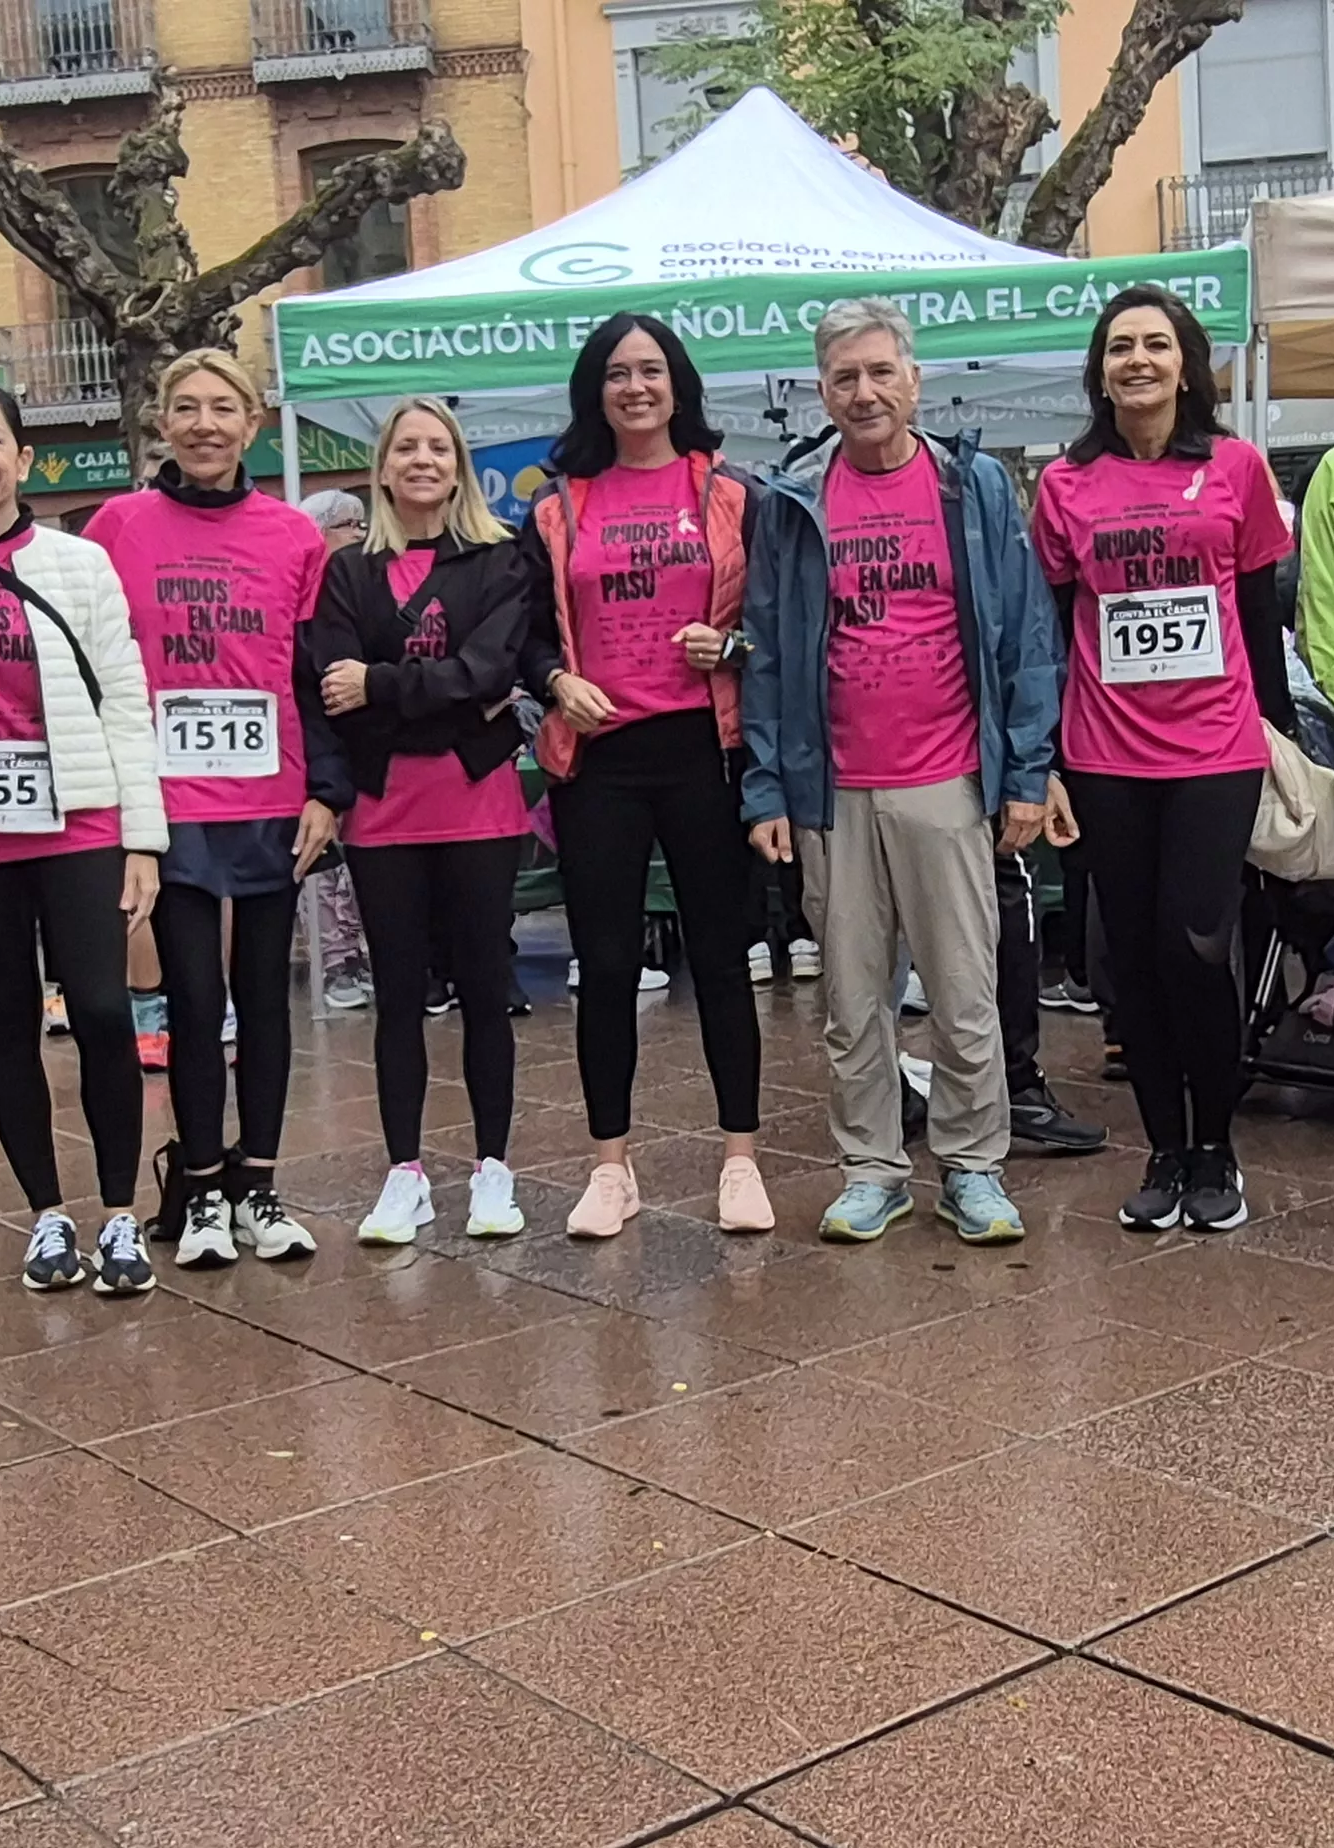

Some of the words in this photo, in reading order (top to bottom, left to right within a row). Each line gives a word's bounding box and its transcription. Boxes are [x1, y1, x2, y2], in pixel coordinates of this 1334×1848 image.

[659, 255, 764, 268] contra
[774, 257, 802, 268] el
[810, 258, 918, 272] cánce
[660, 238, 831, 258] asociación
[841, 247, 988, 263] española
[300, 313, 556, 368] ASOCIACIÓN
[567, 299, 790, 350] EÑOLA
[798, 289, 977, 331] CTRA
[985, 286, 1037, 322] EL
[1045, 273, 1223, 318] CÁER
[74, 451, 117, 468] CAJA
[600, 521, 671, 546] UNIDOS
[1092, 524, 1166, 564] UNIDOS
[630, 544, 653, 569] EN
[657, 541, 708, 567] CADA
[829, 534, 902, 568] UNIDOS
[858, 566, 885, 593] EN
[887, 561, 938, 591] CADA
[1124, 559, 1149, 587] EN
[1152, 555, 1201, 586] CADA
[156, 577, 229, 604] UNIDOS
[187, 604, 212, 633] EN
[217, 605, 264, 635] CADA
[1113, 618, 1207, 657] 1957
[171, 720, 264, 751] 1518
